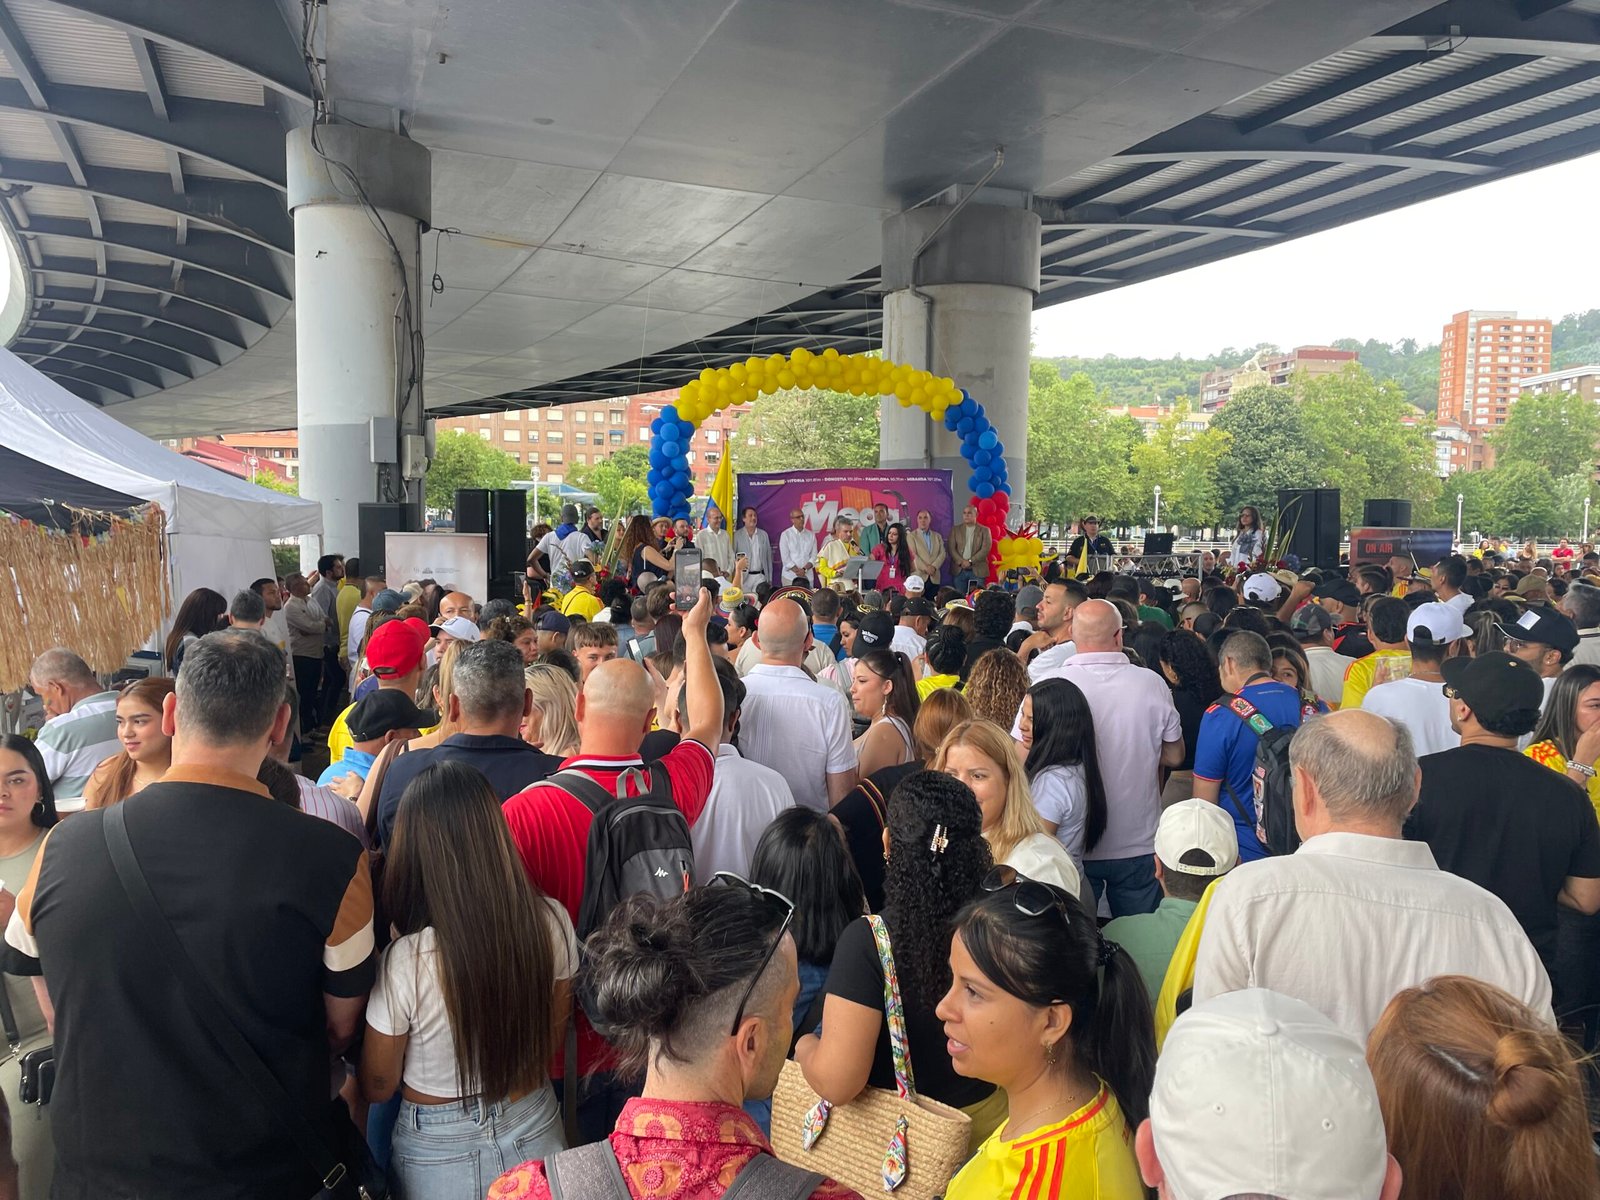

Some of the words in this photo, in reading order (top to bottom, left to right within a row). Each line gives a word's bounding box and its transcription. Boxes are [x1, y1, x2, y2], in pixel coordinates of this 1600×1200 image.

[812, 492, 826, 501] La
[1365, 543, 1377, 553] ON
[1379, 543, 1393, 553] AIR
